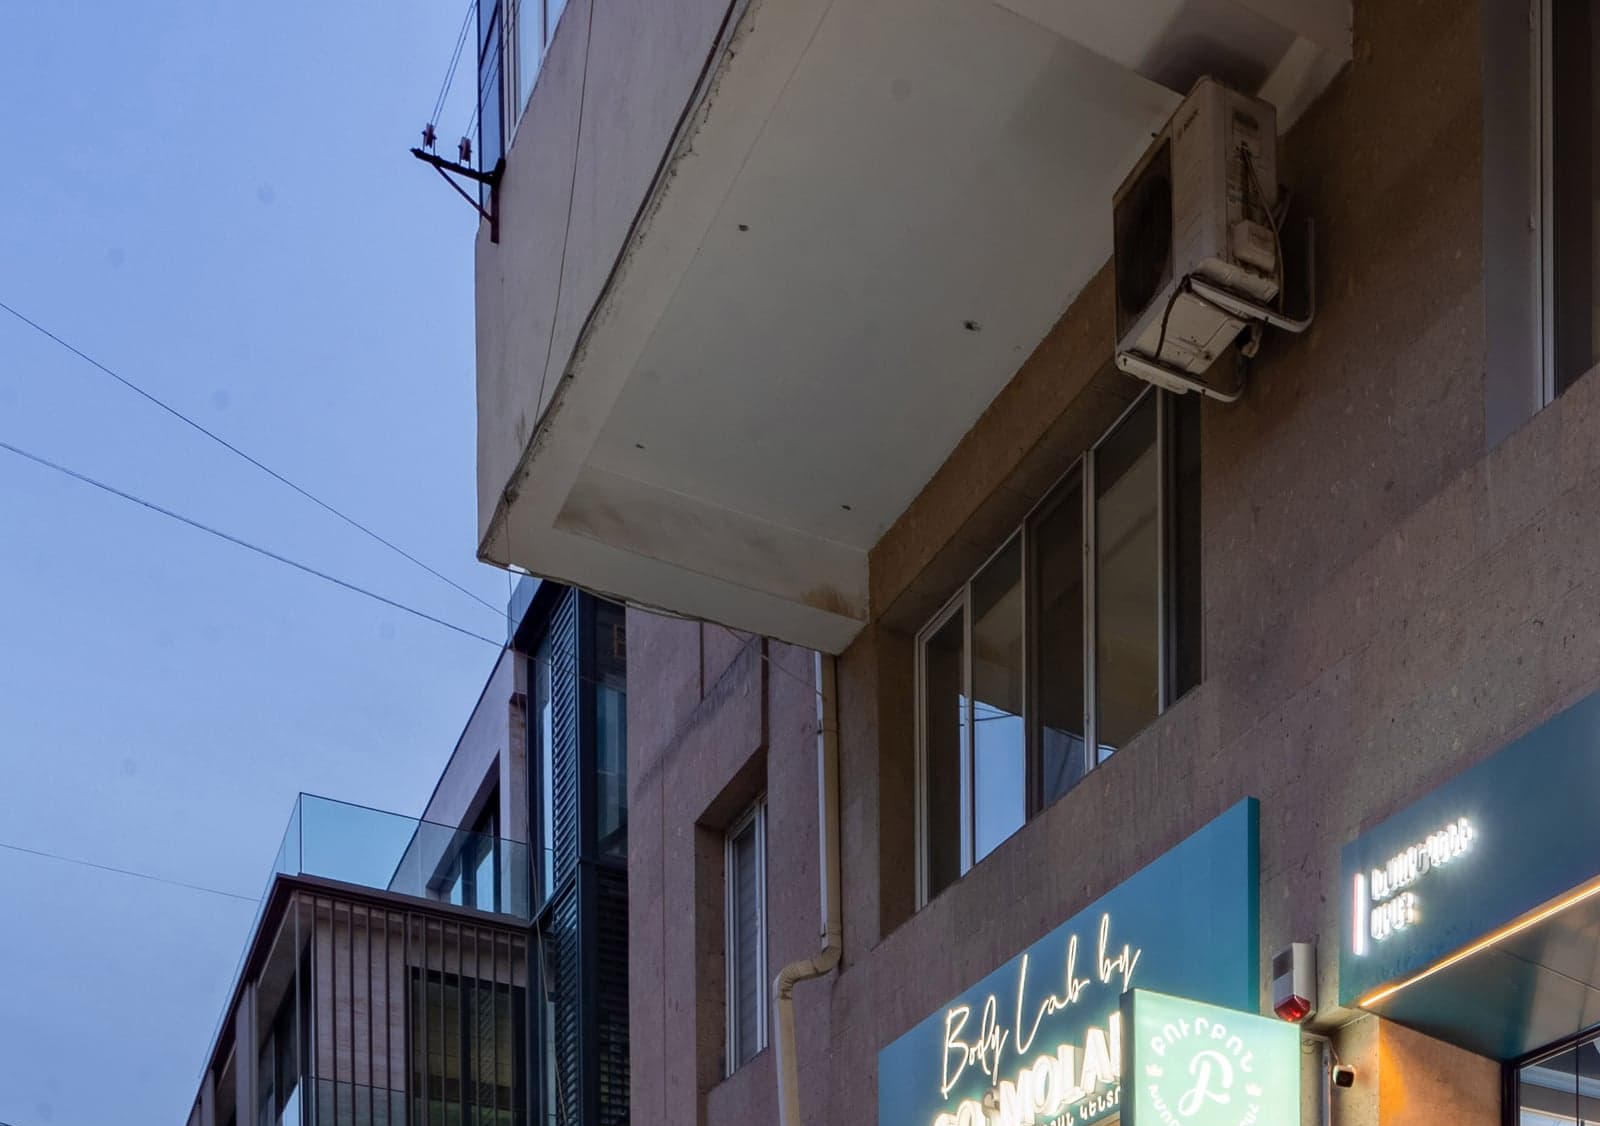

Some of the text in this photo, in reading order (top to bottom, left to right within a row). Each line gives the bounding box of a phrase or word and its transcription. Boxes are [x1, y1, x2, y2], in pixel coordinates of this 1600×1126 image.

[941, 912, 1142, 1100] Body Lab by
